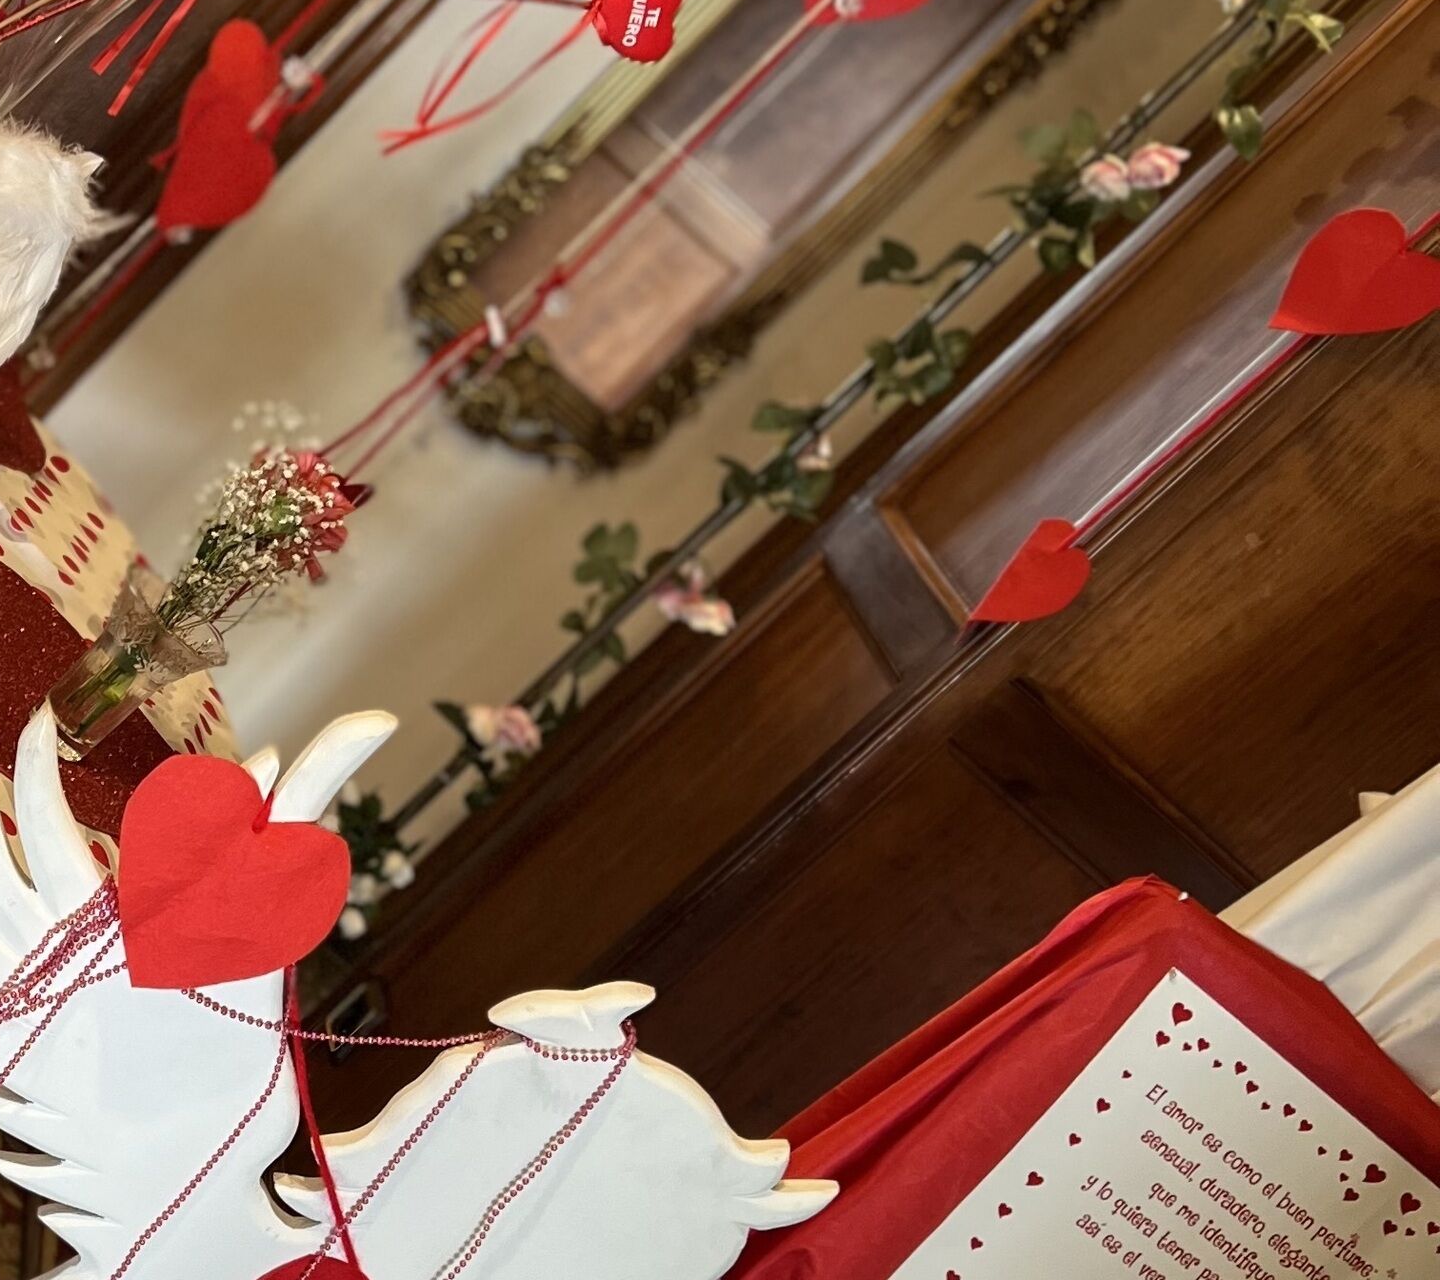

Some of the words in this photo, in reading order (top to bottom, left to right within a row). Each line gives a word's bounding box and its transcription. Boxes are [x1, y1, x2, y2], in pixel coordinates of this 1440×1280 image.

[644, 7, 661, 28] TE
[1140, 1129, 1201, 1182] sensual,
[1199, 1177, 1266, 1238] duradero,
[1146, 1084, 1168, 1105] El
[1162, 1100, 1204, 1134] amor
[1201, 1133, 1223, 1153] es
[1222, 1150, 1262, 1185] como
[1262, 1183, 1282, 1200] el
[1276, 1192, 1315, 1230] buen
[1311, 1225, 1378, 1280] perfume:
[1148, 1182, 1178, 1207] que
[1176, 1204, 1201, 1227] me
[1075, 1214, 1107, 1238] así
[1101, 1234, 1123, 1254] es
[1122, 1252, 1143, 1268] el
[1080, 1175, 1099, 1191] y
[1095, 1181, 1113, 1201] lo
[1111, 1198, 1159, 1238] quiera
[1156, 1231, 1201, 1269] tener
